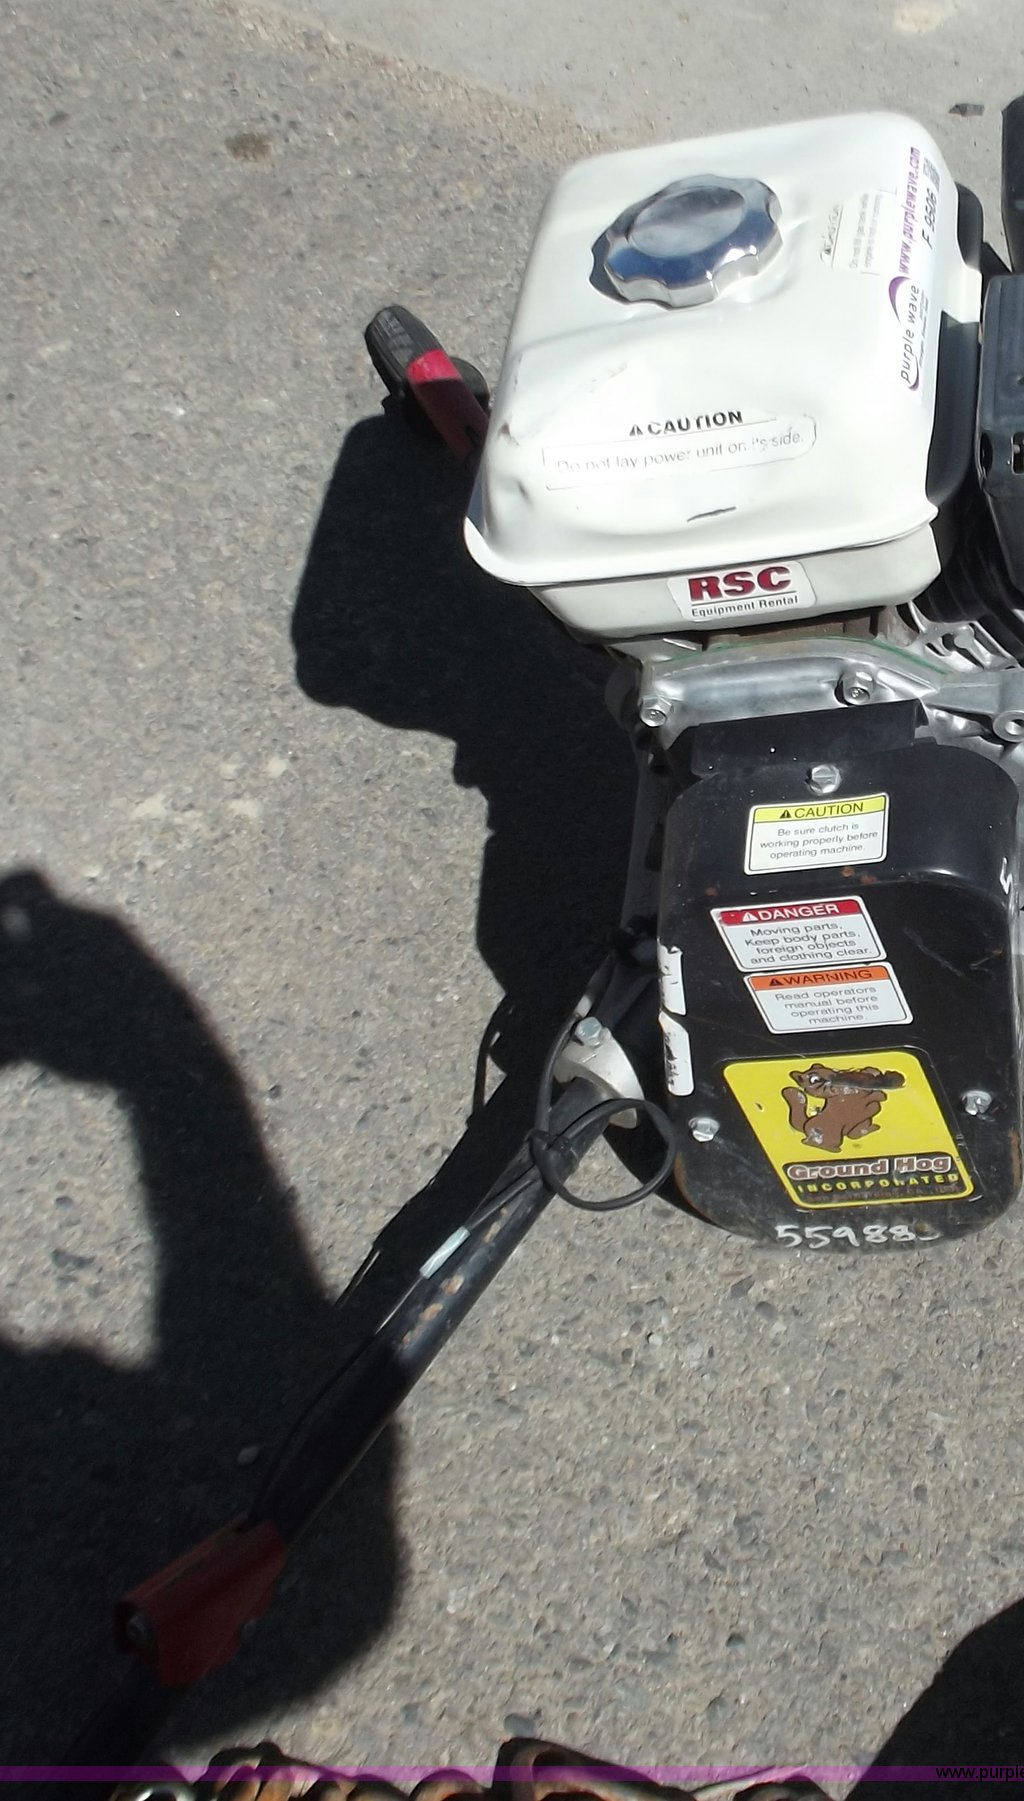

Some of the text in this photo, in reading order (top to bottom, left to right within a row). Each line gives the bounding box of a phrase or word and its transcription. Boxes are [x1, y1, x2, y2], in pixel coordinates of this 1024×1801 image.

[899, 146, 920, 274] www.purplewave.com
[922, 187, 937, 250] F 9506
[900, 285, 920, 384] purple wave
[648, 410, 743, 436] CAUTION
[557, 459, 581, 474] Do
[585, 458, 611, 472] not
[616, 455, 638, 470] lay
[644, 450, 692, 469] power
[696, 443, 724, 458] unit
[728, 440, 747, 454] on
[771, 427, 804, 448] side.
[688, 566, 791, 602] RSC
[691, 595, 798, 618] Equipment Rental
[794, 801, 864, 819] CAUTION
[777, 822, 859, 837] Be sure clutch is
[759, 831, 878, 849] working properly before
[769, 844, 865, 860] operating machine.
[758, 903, 840, 921] DANGER
[751, 921, 843, 938] Moving parts,
[745, 930, 861, 948] Keep body parts,
[756, 940, 857, 955] foreign objects
[750, 946, 872, 965] and clothing clear.
[783, 970, 872, 986] WARNING
[775, 986, 877, 1001] Read operators
[784, 996, 878, 1010] manual before
[790, 1003, 880, 1018] operating this
[808, 1013, 868, 1025] machine.
[787, 1156, 952, 1181] Ground Hog
[797, 1173, 959, 1193] INCORPORATED
